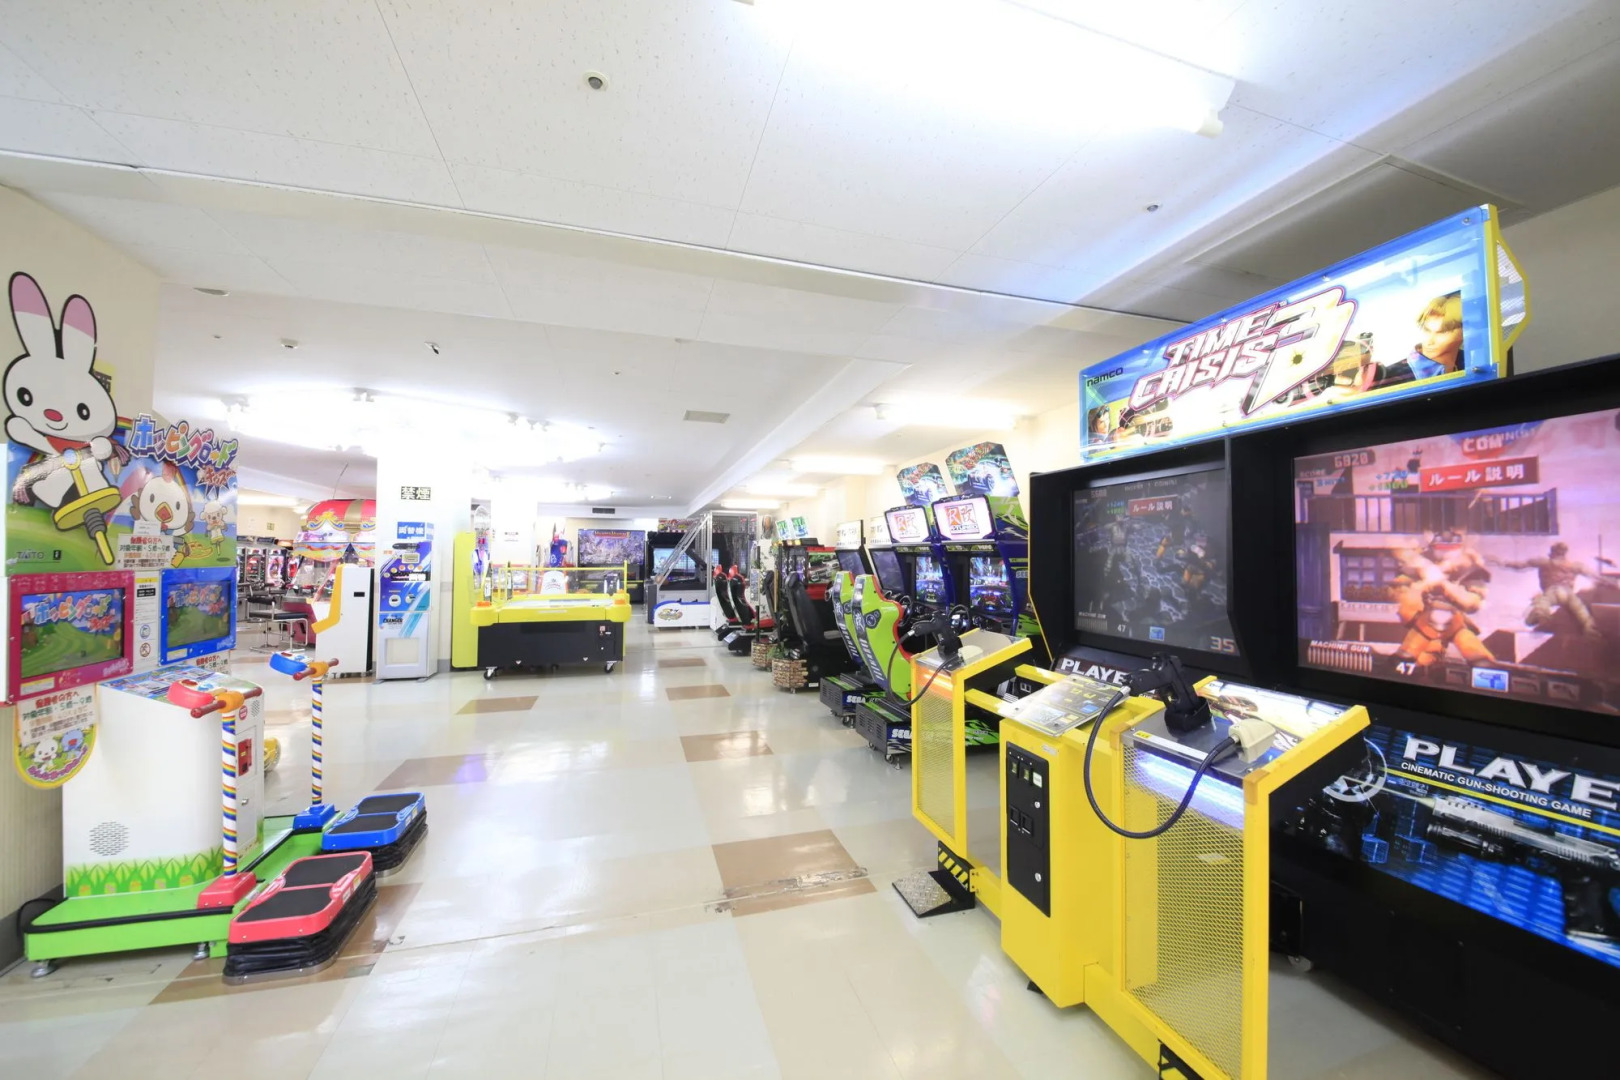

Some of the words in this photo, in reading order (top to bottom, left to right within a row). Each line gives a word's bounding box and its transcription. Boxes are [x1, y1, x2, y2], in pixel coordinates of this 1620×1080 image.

[1165, 303, 1279, 366] TIME
[1086, 366, 1124, 388] namco
[1130, 333, 1279, 410] CRISIS
[1428, 463, 1525, 487] ルール説明
[401, 487, 431, 500] 禁煙
[1132, 501, 1173, 513] ルール説明
[1117, 624, 1126, 632] 47
[1210, 636, 1235, 653] 35
[1310, 640, 1348, 650] MACHINE
[1350, 644, 1369, 653] GUN
[1396, 662, 1416, 675] 47
[846, 695, 866, 703] SEGA
[891, 728, 911, 740] SEG
[1401, 761, 1455, 783] CINEMATIC
[1457, 775, 1548, 807] GUN-SHOOTING
[1551, 800, 1592, 819] GAME
